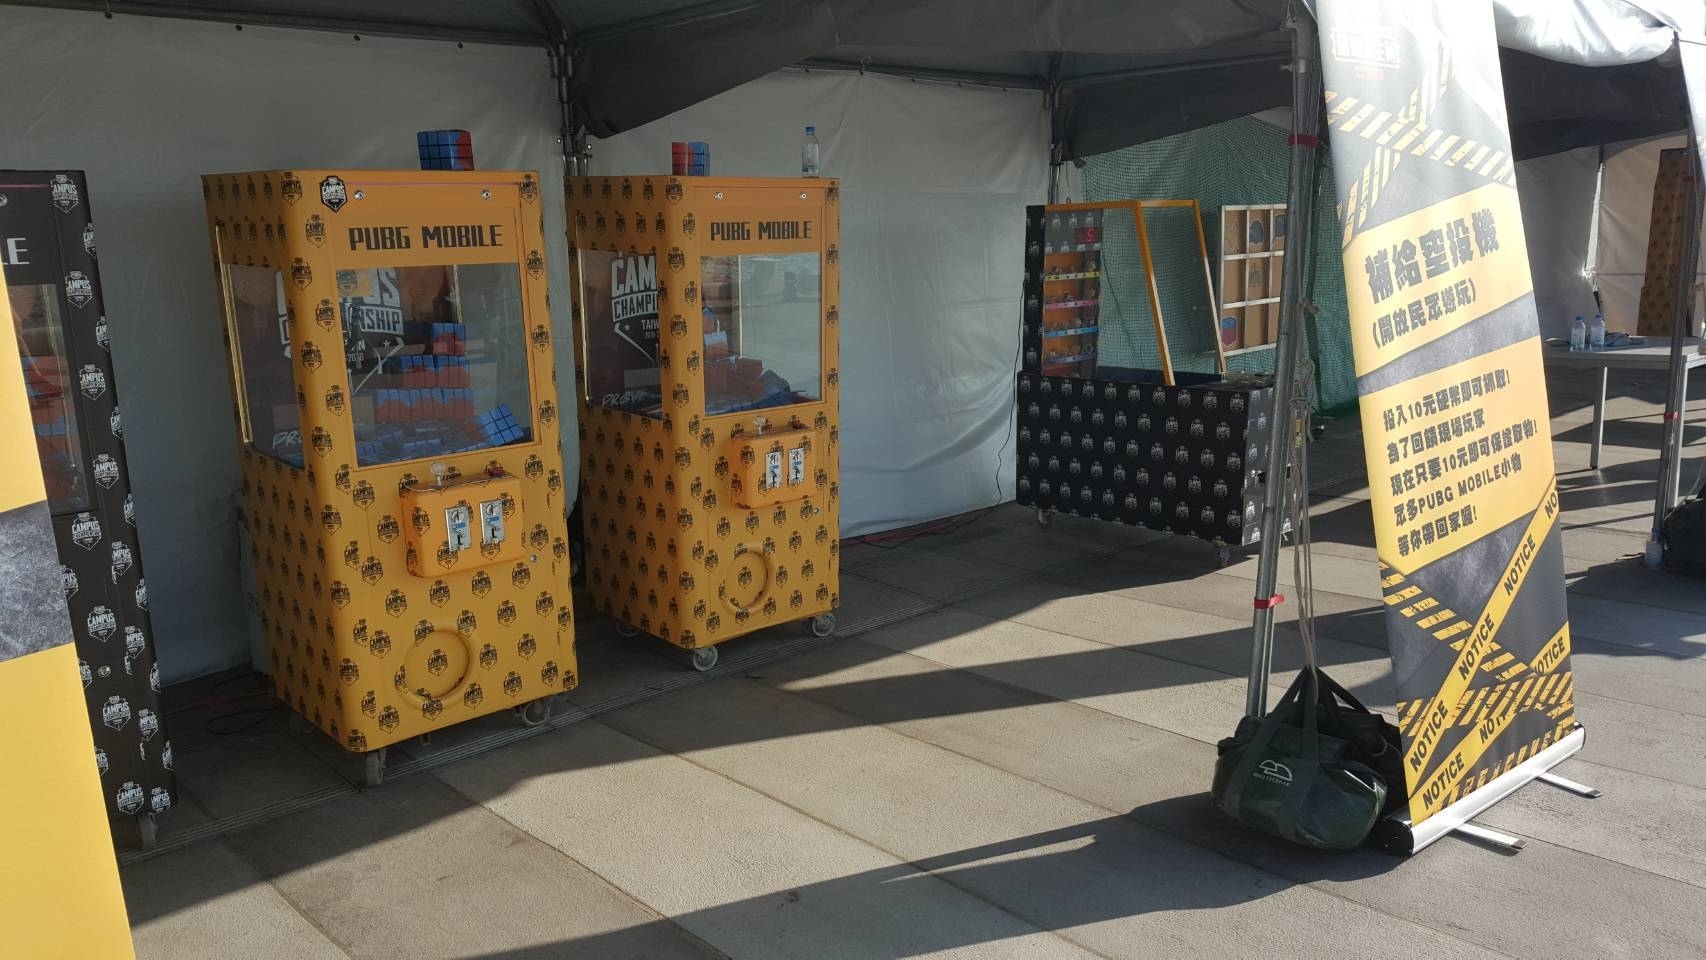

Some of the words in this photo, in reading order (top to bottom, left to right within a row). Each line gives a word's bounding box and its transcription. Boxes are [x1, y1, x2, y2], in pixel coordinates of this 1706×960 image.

[322, 185, 345, 194] CAMPUS
[348, 227, 411, 251] PUBG
[422, 225, 503, 249] MOBILE
[711, 222, 750, 241] PUBG
[759, 220, 813, 239] MOBILE
[1365, 208, 1500, 304] 補給空投機
[612, 255, 657, 297] CAM
[72, 521, 100, 533] CAMPUS
[1503, 533, 1535, 596] NOTICE
[87, 613, 115, 625] CAMPUS
[1458, 613, 1494, 680] NOTICE
[102, 701, 129, 714] CAMPUS
[1410, 700, 1448, 773] NOTICE
[117, 787, 143, 800] CAMPUS
[1422, 751, 1465, 810] NOTICE
